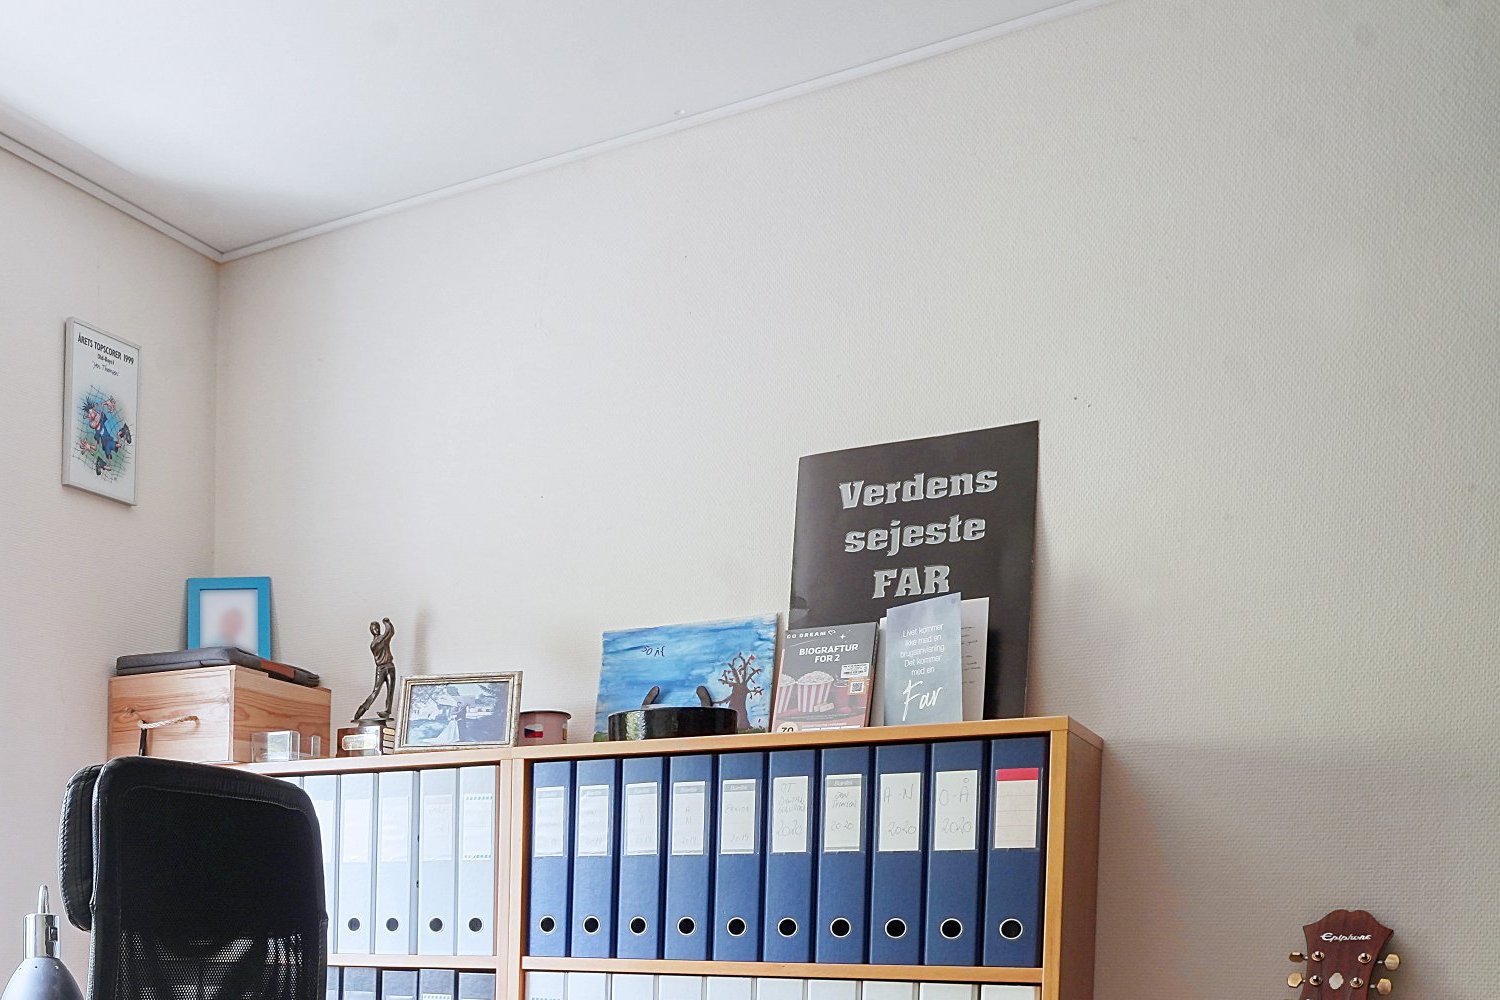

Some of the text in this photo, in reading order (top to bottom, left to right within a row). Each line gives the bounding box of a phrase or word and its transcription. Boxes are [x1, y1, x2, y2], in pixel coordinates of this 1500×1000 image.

[94, 341, 121, 360] TOPSCORER
[123, 354, 134, 365] 1999
[839, 470, 998, 509] Verdens
[844, 514, 986, 557] sejeste
[872, 565, 950, 599] FAR
[903, 624, 944, 638] Livet kommer
[918, 636, 932, 644] med
[799, 643, 859, 656] BIOGRAFTUR
[814, 654, 841, 663] FOR 2
[904, 655, 942, 667] Det kommer
[911, 668, 925, 676] med
[902, 680, 943, 721] Far
[1320, 932, 1372, 942] Epiphone
